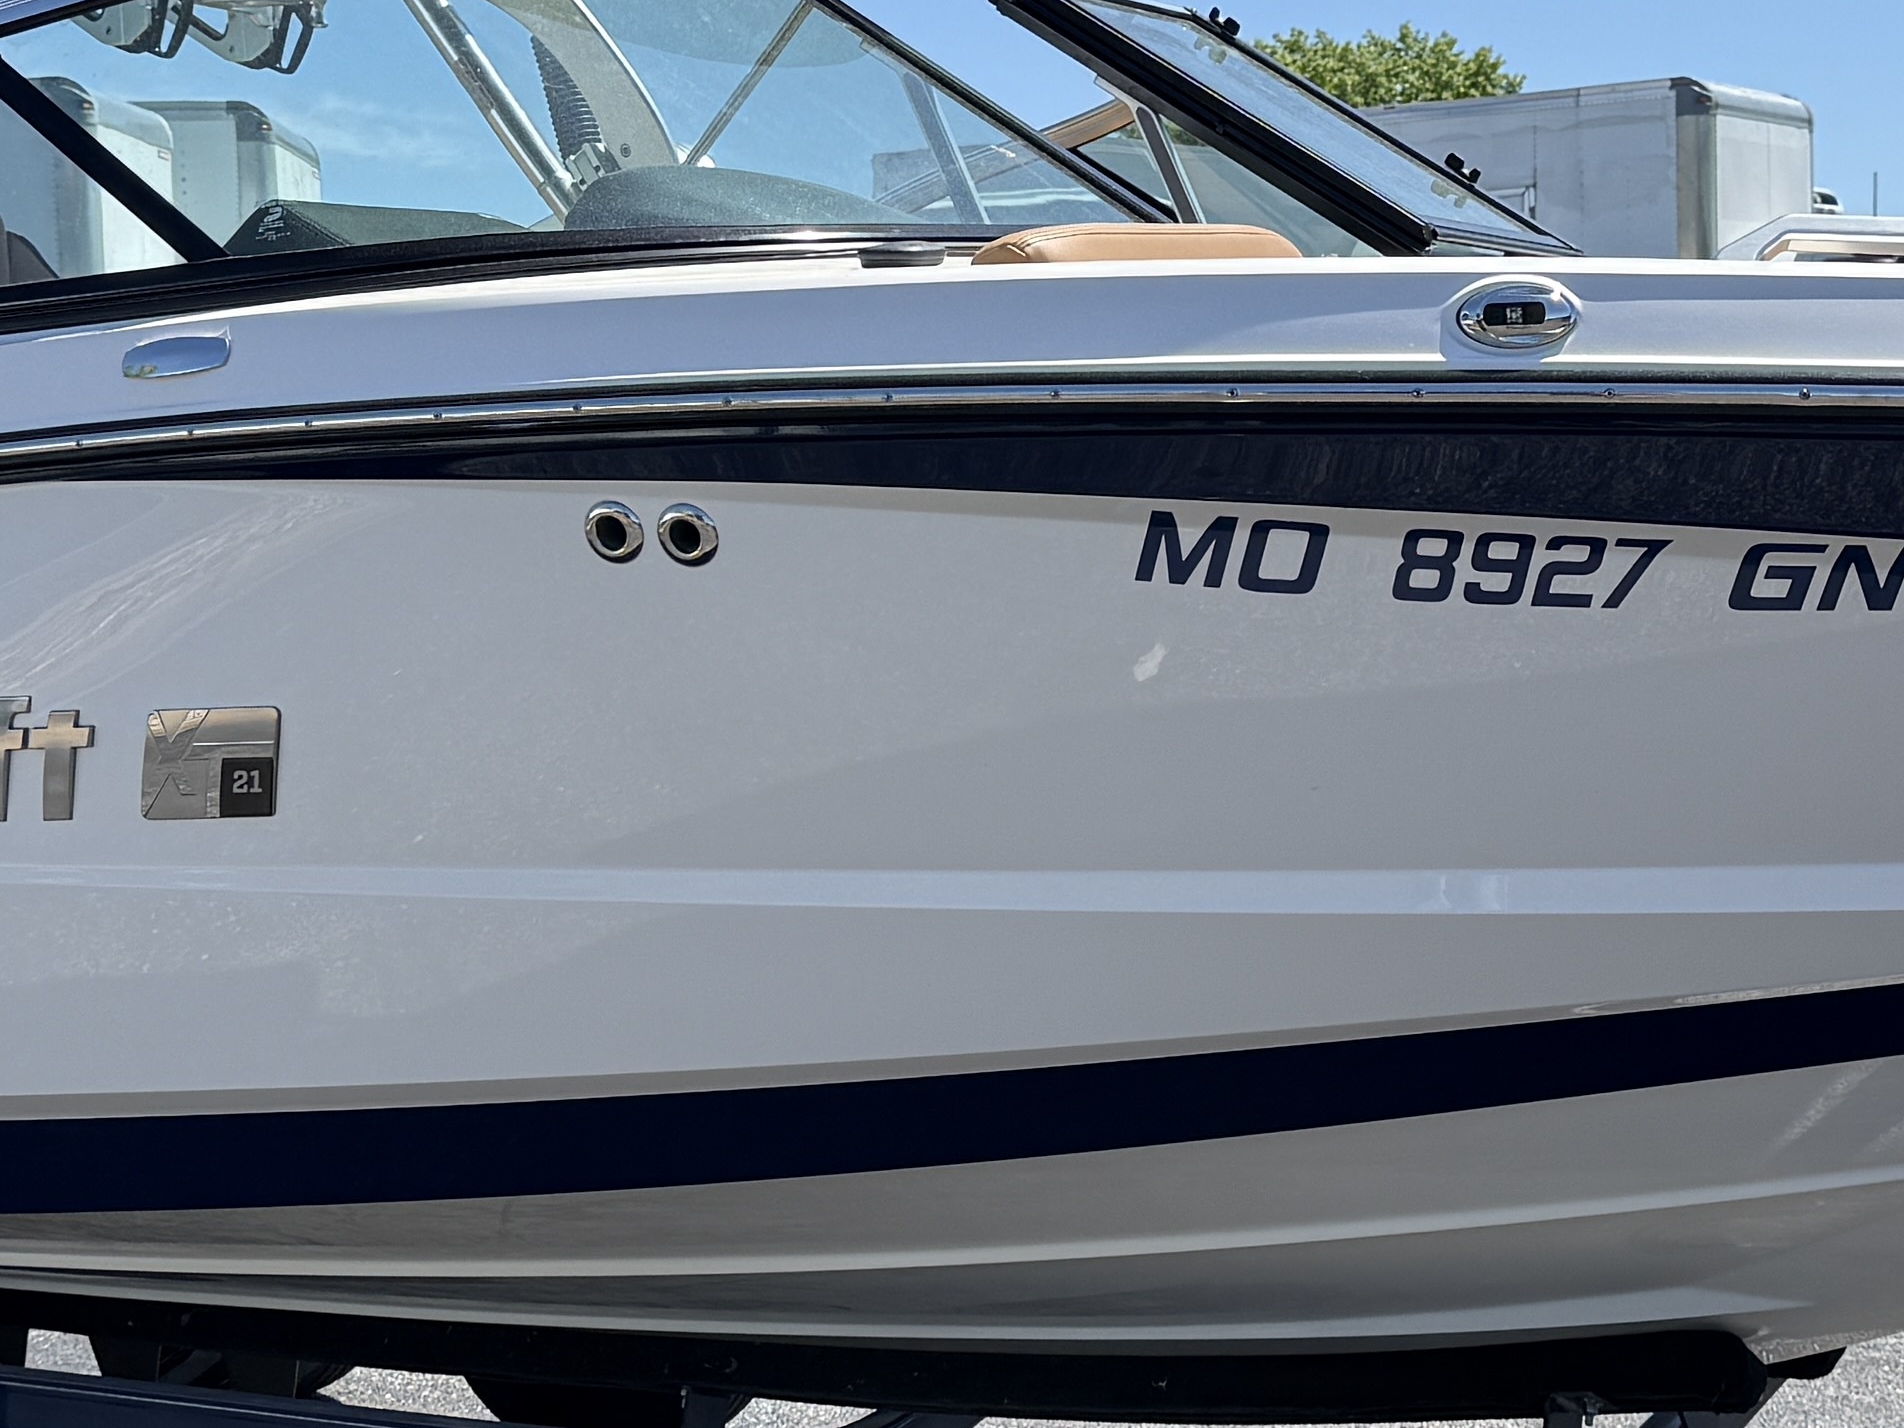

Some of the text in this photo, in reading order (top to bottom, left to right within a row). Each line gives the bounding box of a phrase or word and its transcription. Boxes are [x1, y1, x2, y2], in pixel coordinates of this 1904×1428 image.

[1134, 509, 1331, 595] MO
[1391, 528, 1675, 609] 8927
[232, 769, 263, 794] 21
